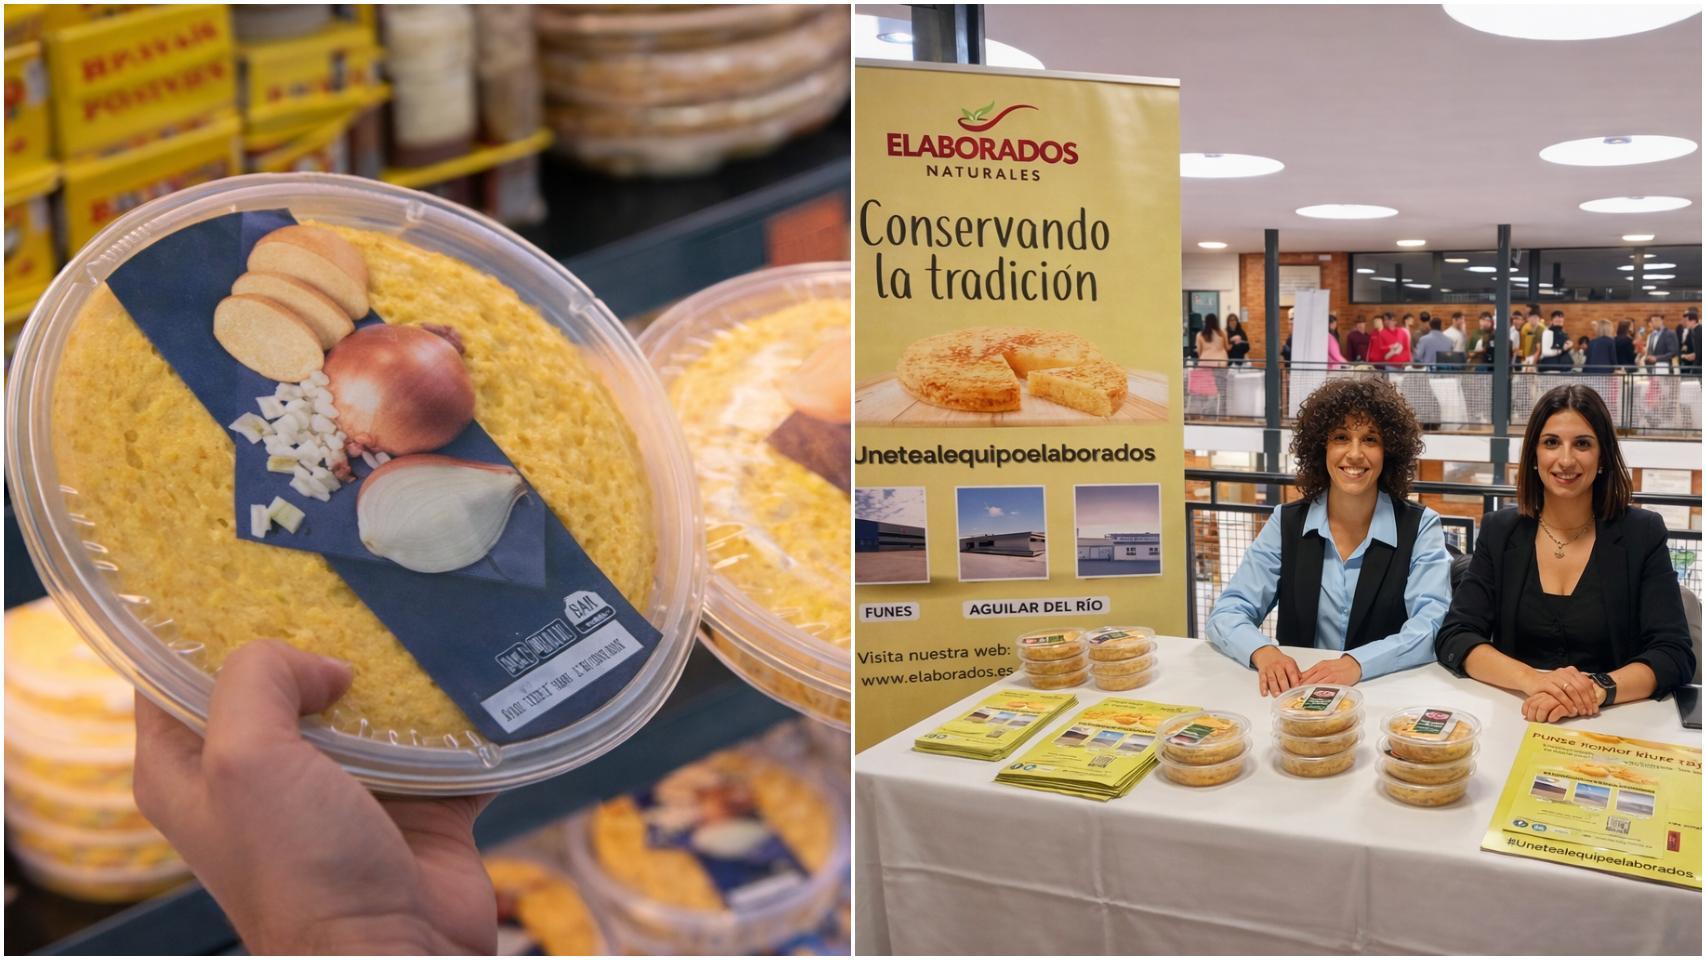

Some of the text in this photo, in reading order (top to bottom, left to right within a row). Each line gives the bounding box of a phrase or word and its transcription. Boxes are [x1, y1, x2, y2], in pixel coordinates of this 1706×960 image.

[887, 133, 1079, 165] ELABORADOS
[926, 165, 1041, 182] NATURALES
[860, 199, 1110, 251] Conservando
[876, 252, 1098, 302] la tradición
[865, 606, 913, 618] FUNES
[969, 597, 1103, 616] AGUILAR DEL RÍO
[857, 643, 1012, 665] Visita nuestra web:
[861, 664, 1013, 687] www.elaborados.es
